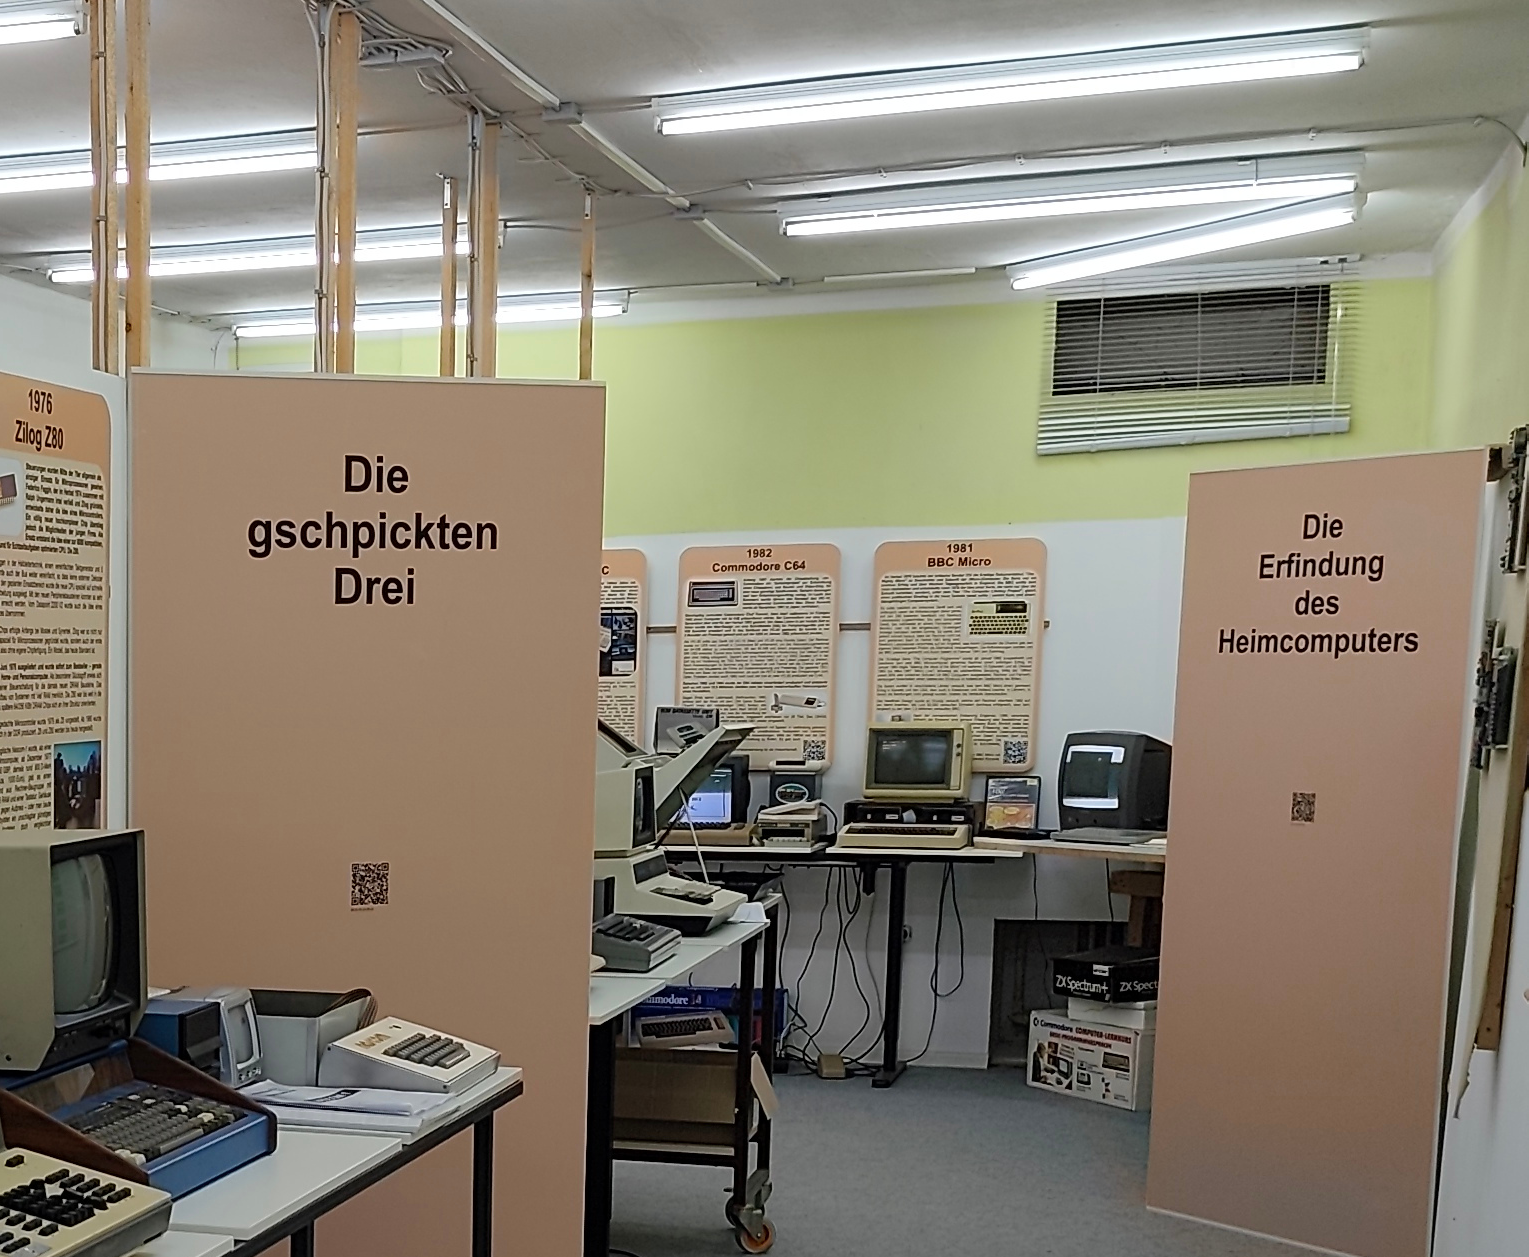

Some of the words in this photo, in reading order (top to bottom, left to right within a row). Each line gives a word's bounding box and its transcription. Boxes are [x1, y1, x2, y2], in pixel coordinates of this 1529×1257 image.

[28, 388, 53, 415] 1976
[15, 419, 43, 452] Zilog
[44, 425, 64, 450] Z80
[344, 454, 409, 494] Die
[248, 511, 498, 559] gschpickten
[1302, 512, 1344, 540] Die
[746, 548, 773, 559] 1982
[927, 556, 954, 568] BBC
[957, 556, 992, 568] Micro
[946, 543, 973, 554] 1981
[712, 560, 781, 574] Commodore
[784, 560, 807, 572] C64
[1259, 550, 1385, 582] Erfindung
[334, 567, 415, 605] Drei
[1294, 589, 1339, 616] des
[1218, 627, 1419, 660] Heimcomputers
[1055, 974, 1067, 988] ZX
[1067, 975, 1109, 994] Spectrum+
[1119, 981, 1133, 993] ZX
[1133, 980, 1159, 993] Spect
